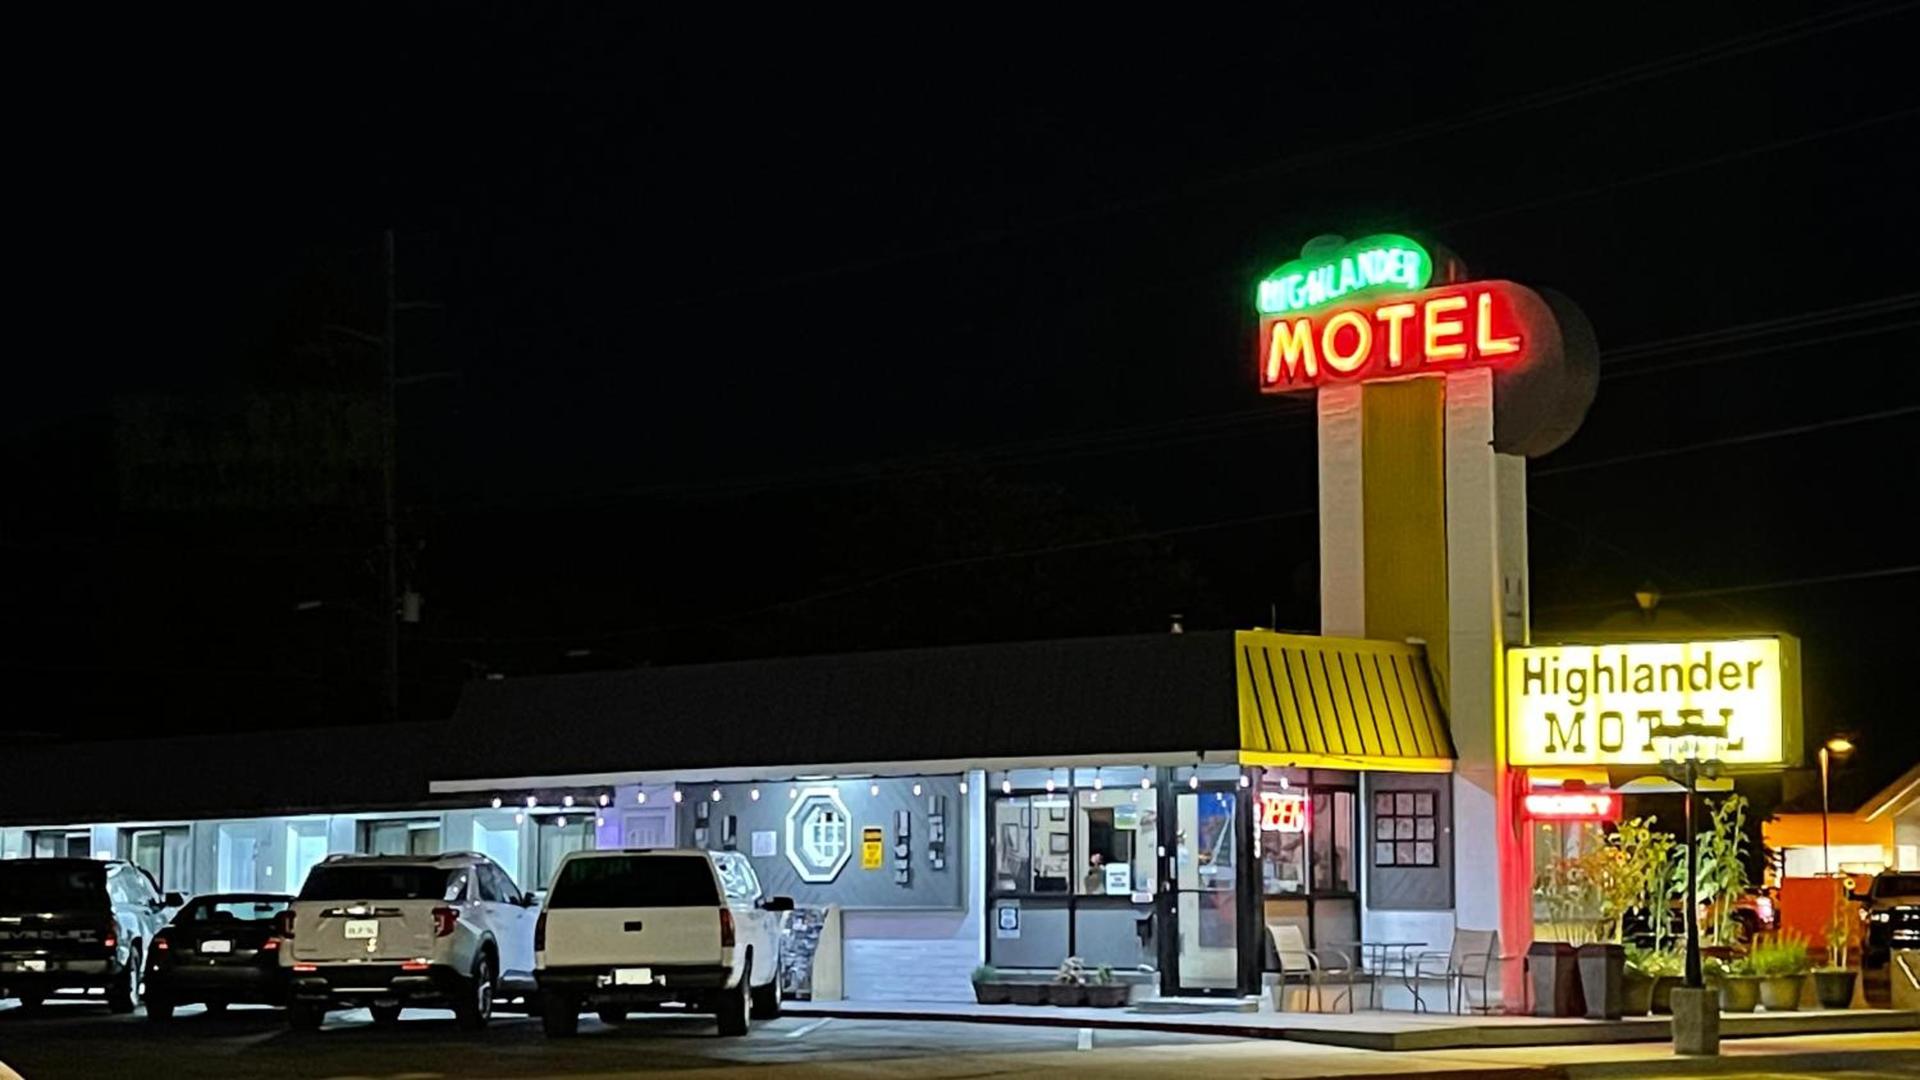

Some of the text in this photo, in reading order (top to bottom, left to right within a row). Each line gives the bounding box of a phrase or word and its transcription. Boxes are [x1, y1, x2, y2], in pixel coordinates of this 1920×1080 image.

[1259, 248, 1421, 312] HIGHLANDER
[1266, 291, 1521, 383] MOTEL
[1522, 651, 1763, 707] Highlander
[1259, 791, 1305, 833] OPEN
